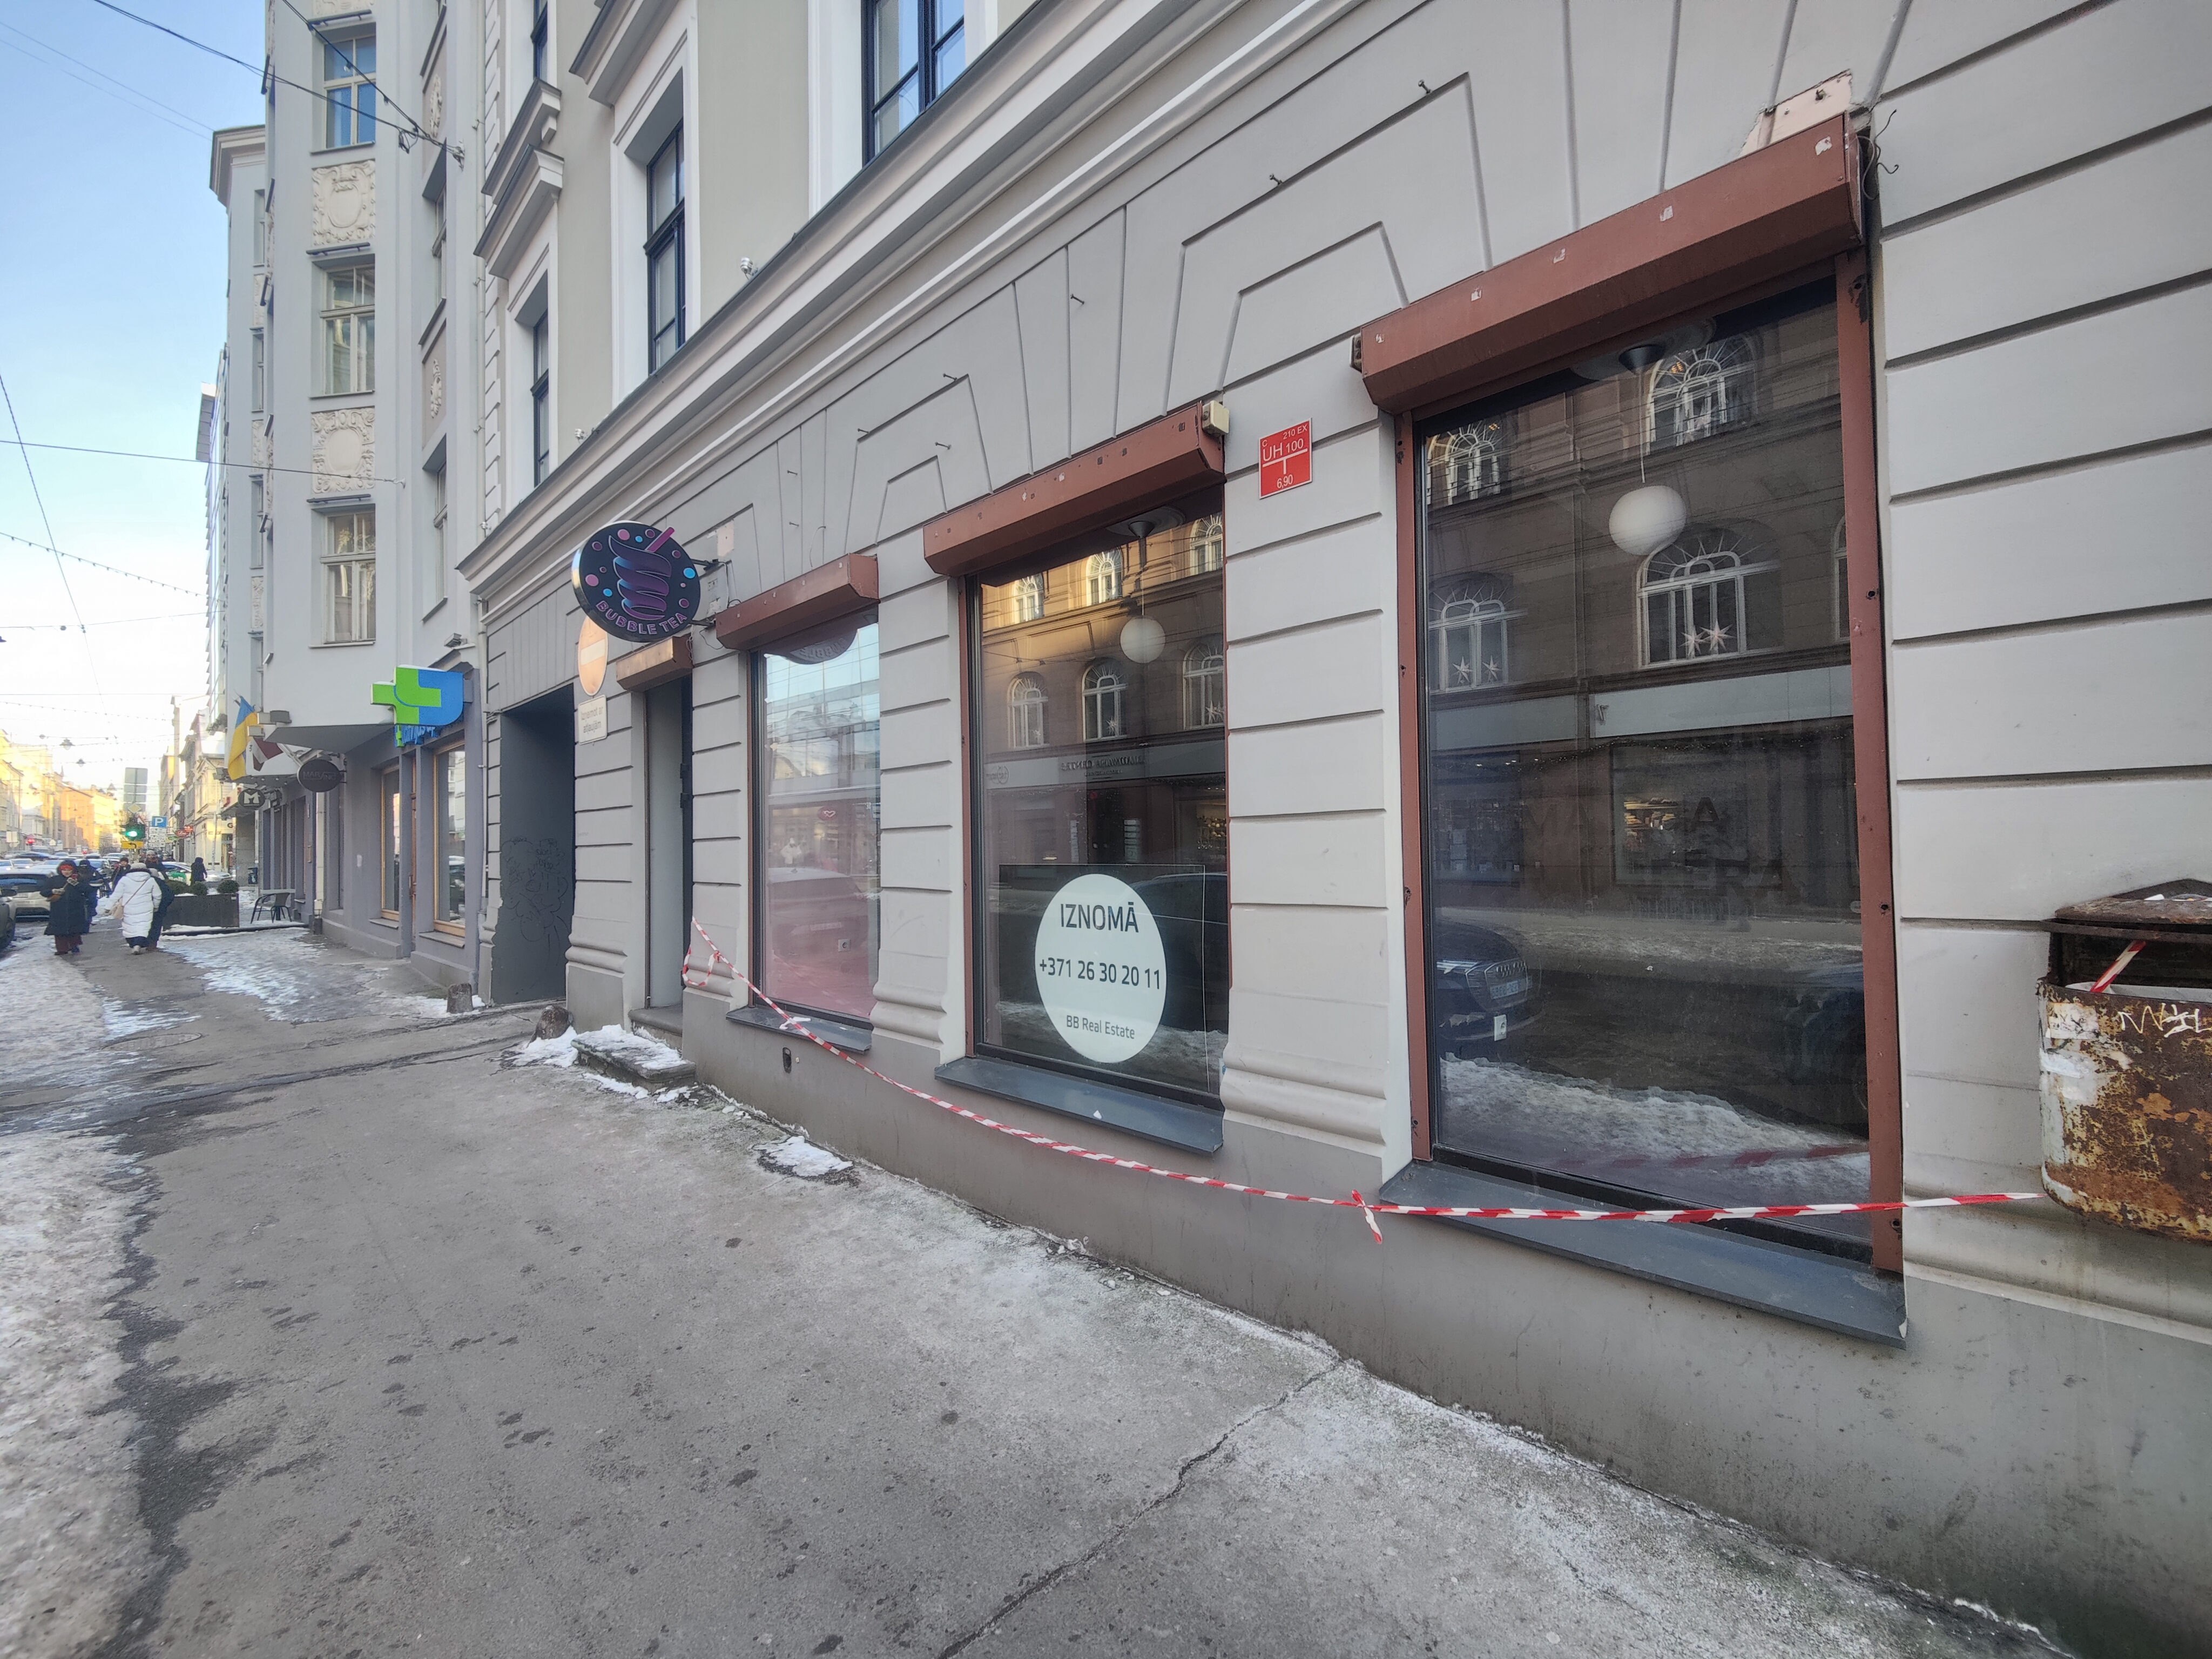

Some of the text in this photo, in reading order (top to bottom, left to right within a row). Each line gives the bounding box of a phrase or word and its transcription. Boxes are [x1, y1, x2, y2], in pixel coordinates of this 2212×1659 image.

[1283, 424, 1307, 440] 210 EX
[1263, 438, 1304, 461] UH 100
[1277, 474, 1293, 489] 6,90
[596, 600, 687, 635] BUBBLE TEA
[154, 817, 164, 826] P
[1060, 901, 1139, 933] IZNOMĀ
[1039, 957, 1161, 989] +371 26 30 20 11
[1066, 1015, 1135, 1040] BB Real Estate
